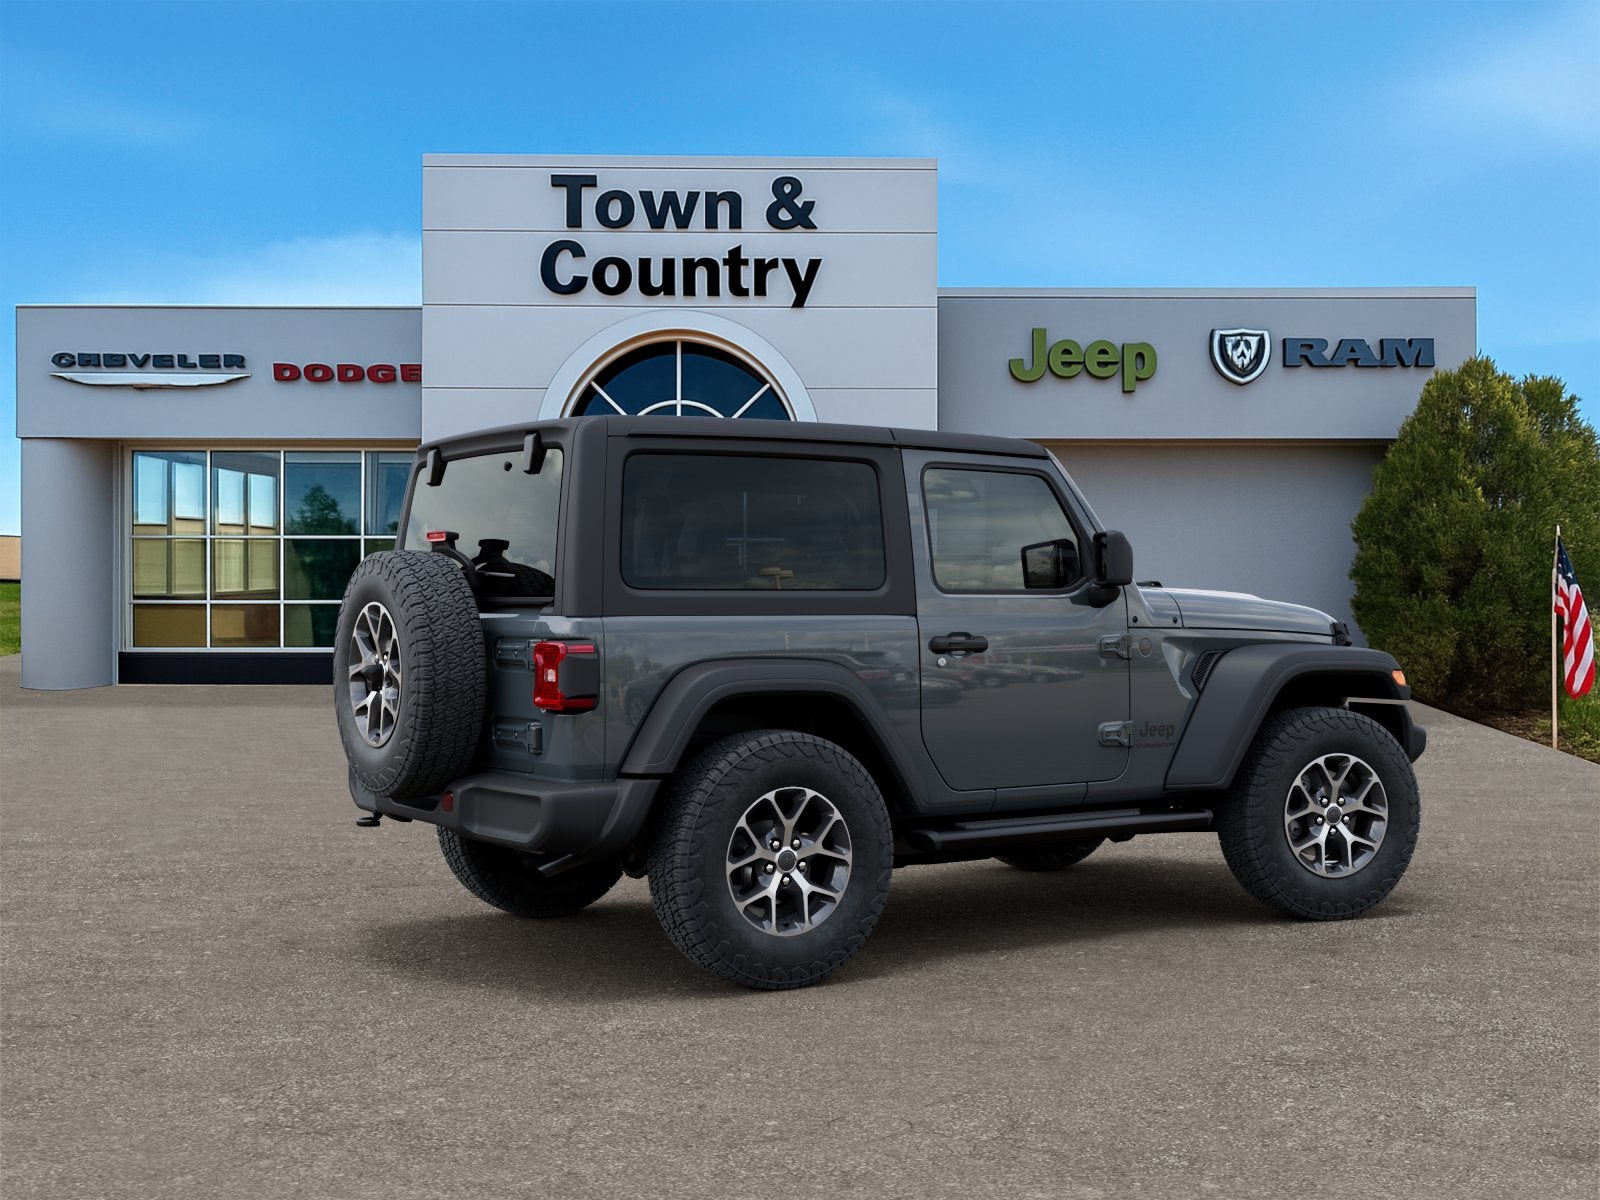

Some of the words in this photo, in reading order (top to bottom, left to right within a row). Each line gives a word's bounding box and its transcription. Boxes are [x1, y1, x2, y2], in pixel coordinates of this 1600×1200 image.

[550, 174, 742, 230] Town
[765, 175, 818, 230] &
[539, 239, 822, 309] Country
[272, 362, 422, 384] DODGE
[1008, 327, 1158, 393] Jeep
[1282, 337, 1436, 368] RAM
[1138, 720, 1175, 739] Jeep
